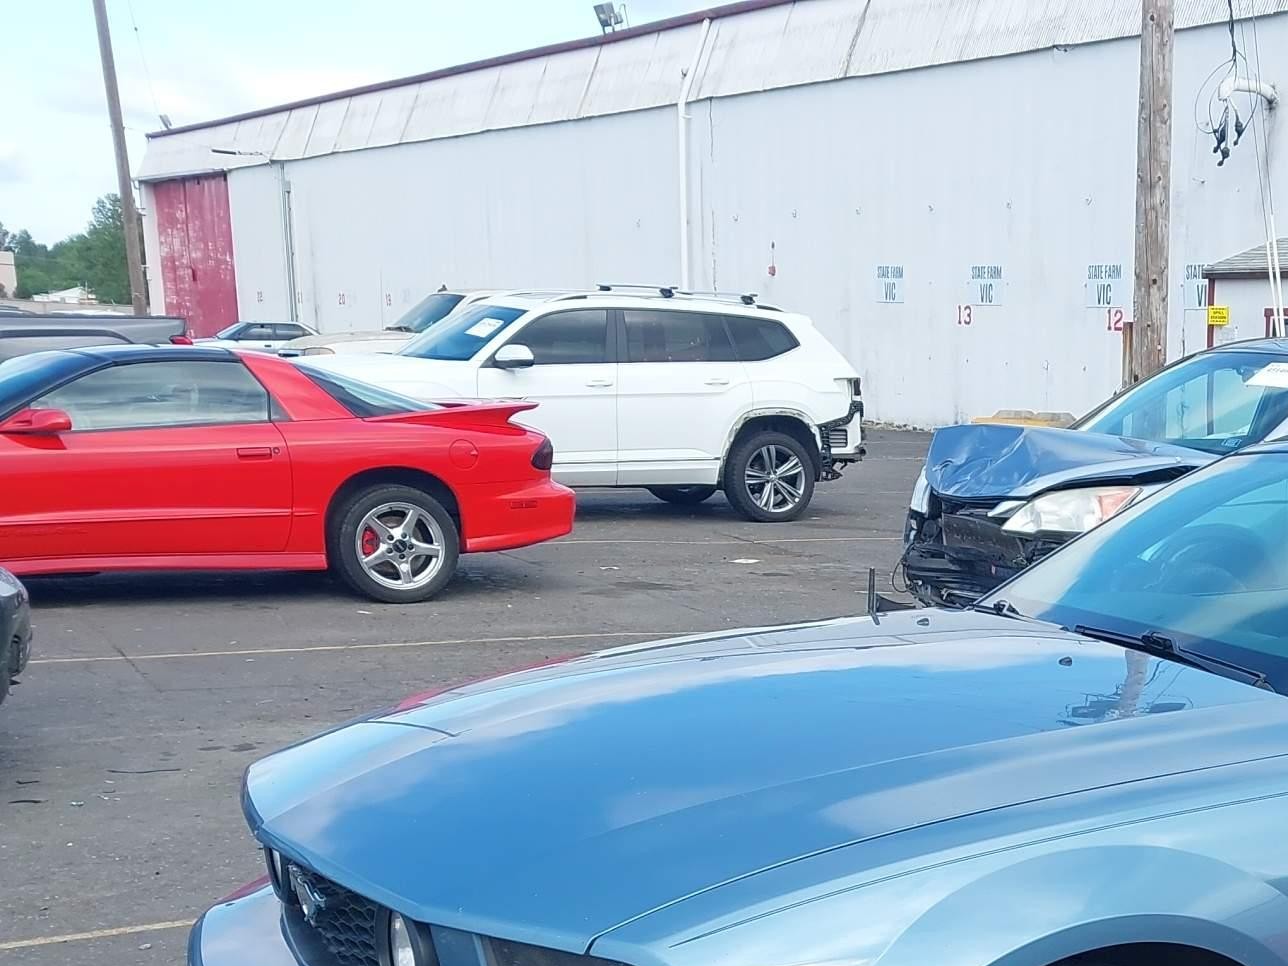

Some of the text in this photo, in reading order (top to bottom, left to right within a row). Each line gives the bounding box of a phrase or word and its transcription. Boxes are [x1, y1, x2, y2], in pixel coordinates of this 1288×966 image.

[971, 265, 1002, 280] STATE FARM
[1087, 264, 1122, 280] STATE FARM
[884, 282, 896, 301] VIC
[979, 283, 993, 304] VIC
[1096, 283, 1112, 306] VIC
[1196, 284, 1207, 307] VI
[957, 304, 972, 325] 13
[1107, 307, 1123, 332] 12
